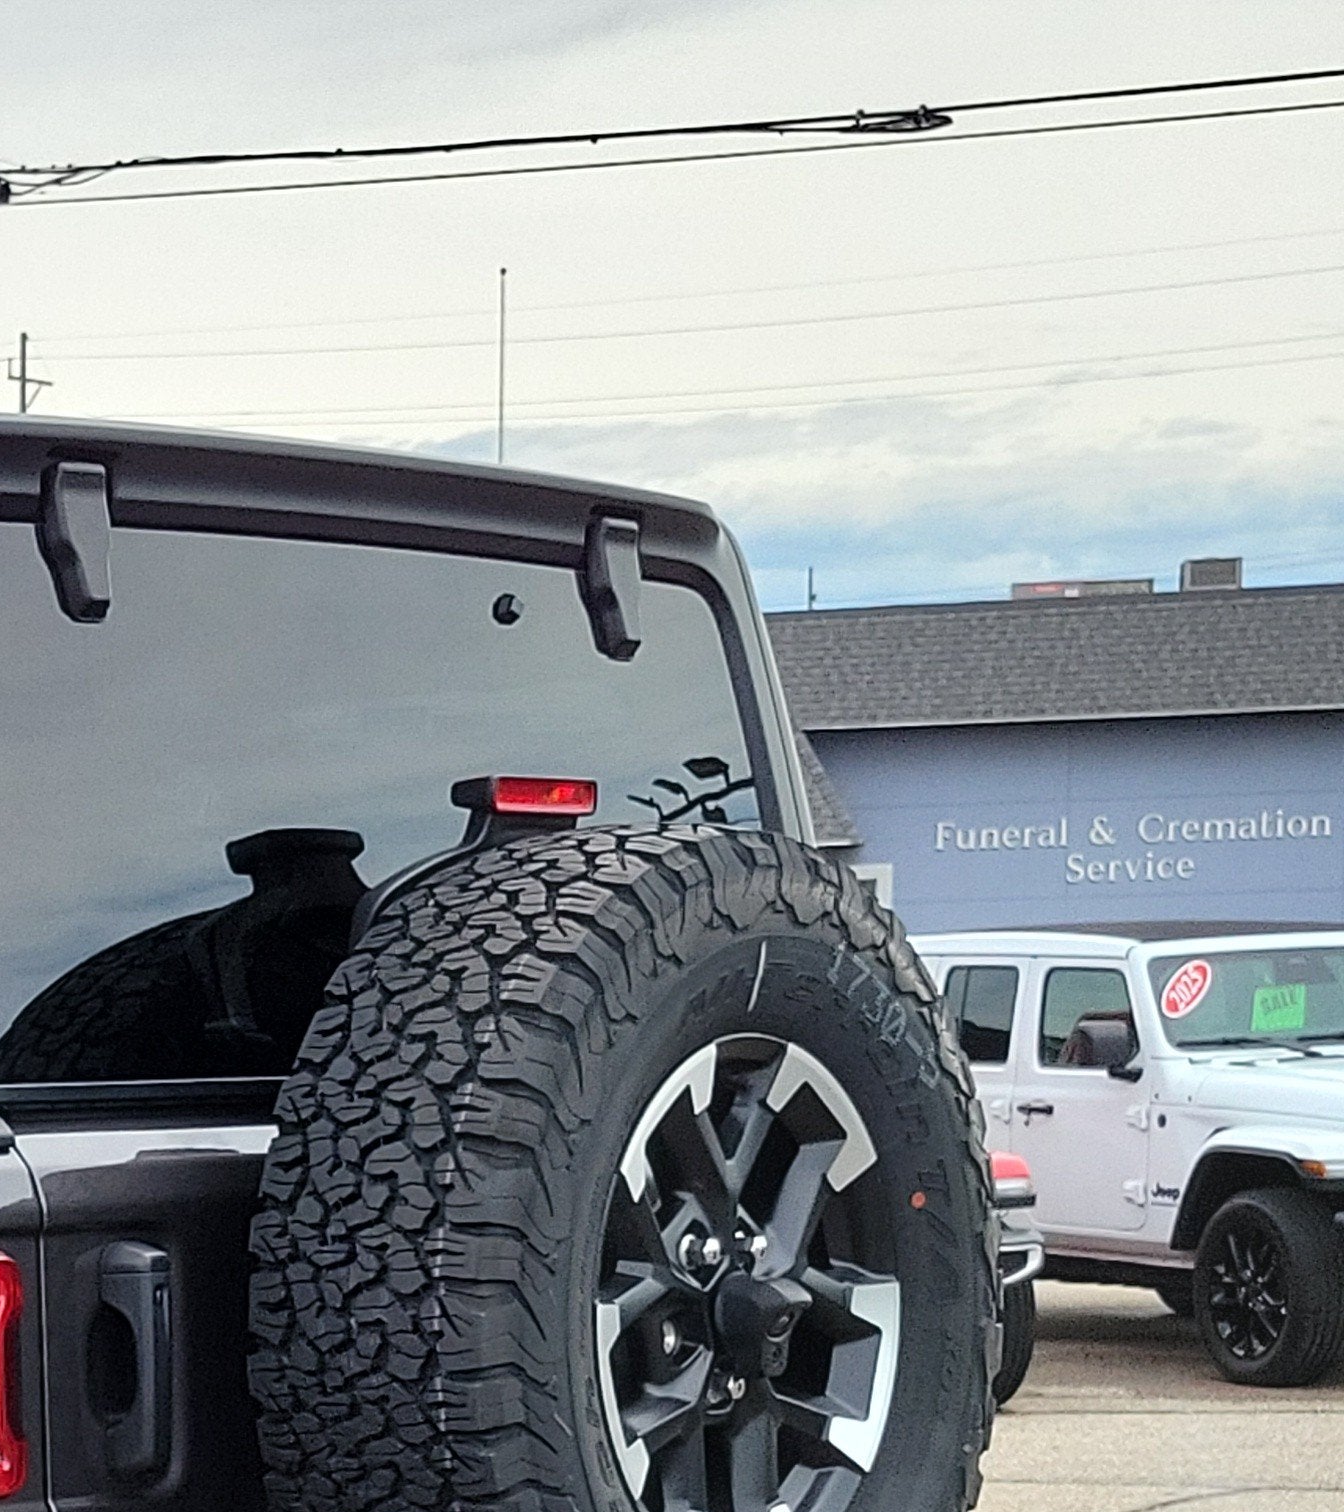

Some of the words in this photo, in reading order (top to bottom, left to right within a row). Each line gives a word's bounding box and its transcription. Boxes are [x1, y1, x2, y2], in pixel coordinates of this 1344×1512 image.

[934, 817, 1069, 852] Funeral
[1088, 815, 1116, 846] &
[1137, 809, 1332, 844] Cremation
[1065, 851, 1196, 884] Service
[1168, 964, 1205, 1011] 2025
